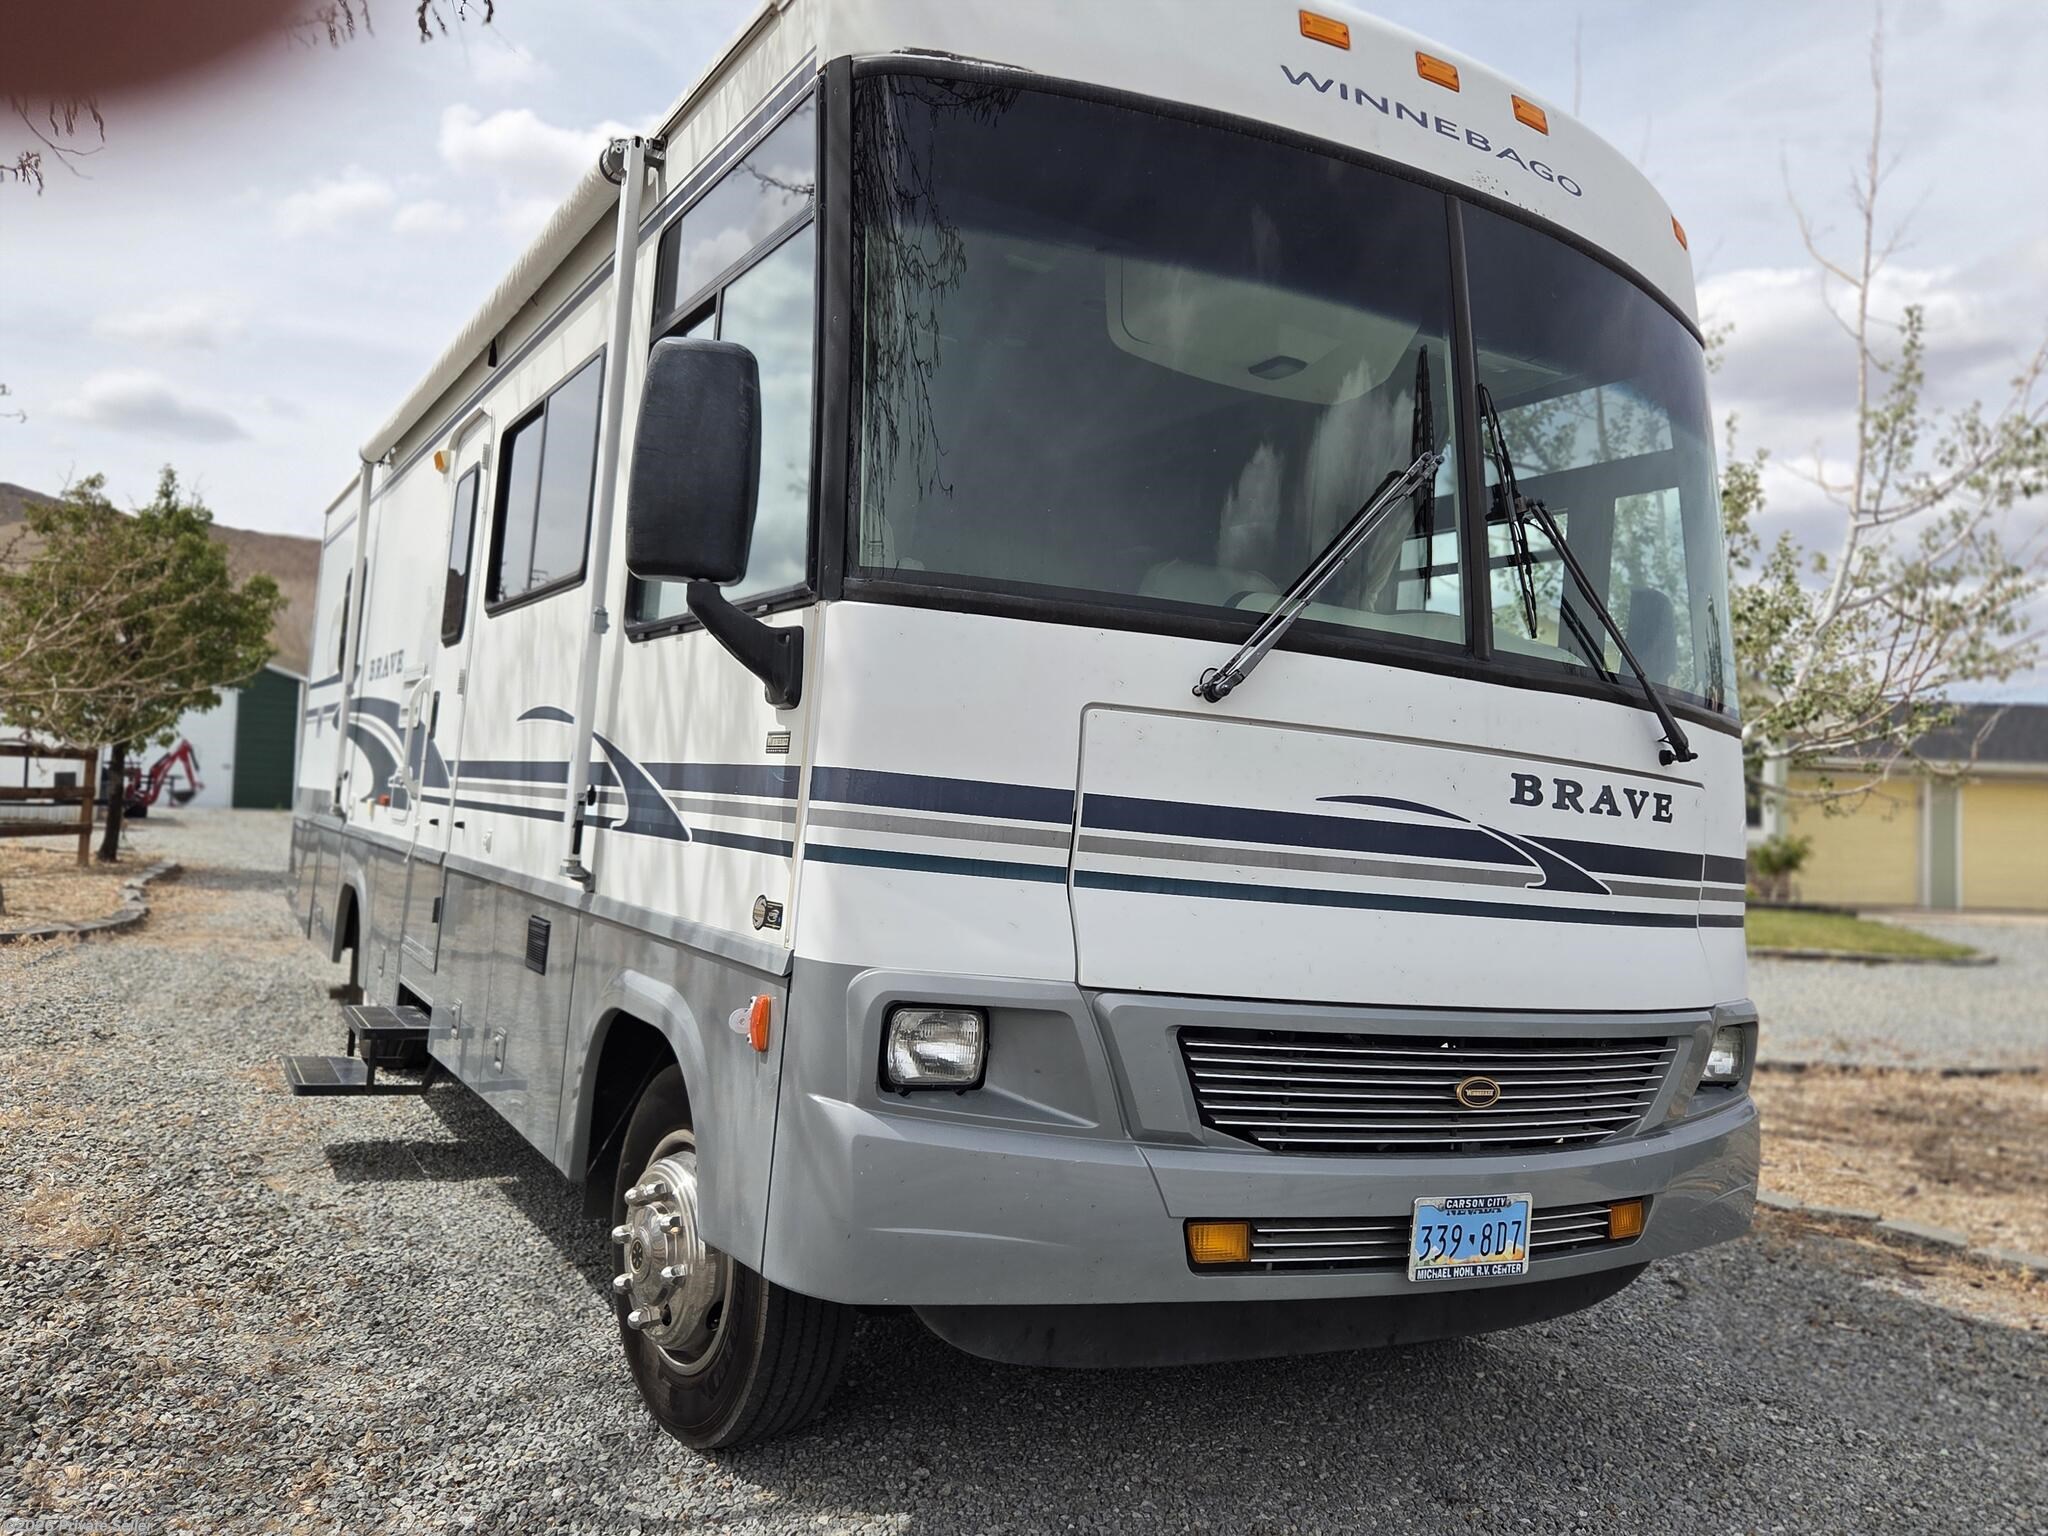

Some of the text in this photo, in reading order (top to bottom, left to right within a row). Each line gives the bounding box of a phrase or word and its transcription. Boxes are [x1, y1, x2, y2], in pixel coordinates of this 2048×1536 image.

[1280, 64, 1583, 198] WINNEBAGO
[369, 649, 405, 682] BRAVE
[1509, 772, 1674, 824] BRAVE
[1446, 1197, 1506, 1209] CARSON CITY
[1417, 1267, 1452, 1280] MICHAEL
[1453, 1266, 1475, 1278] HOHL
[1492, 1263, 1522, 1275] CENTER
